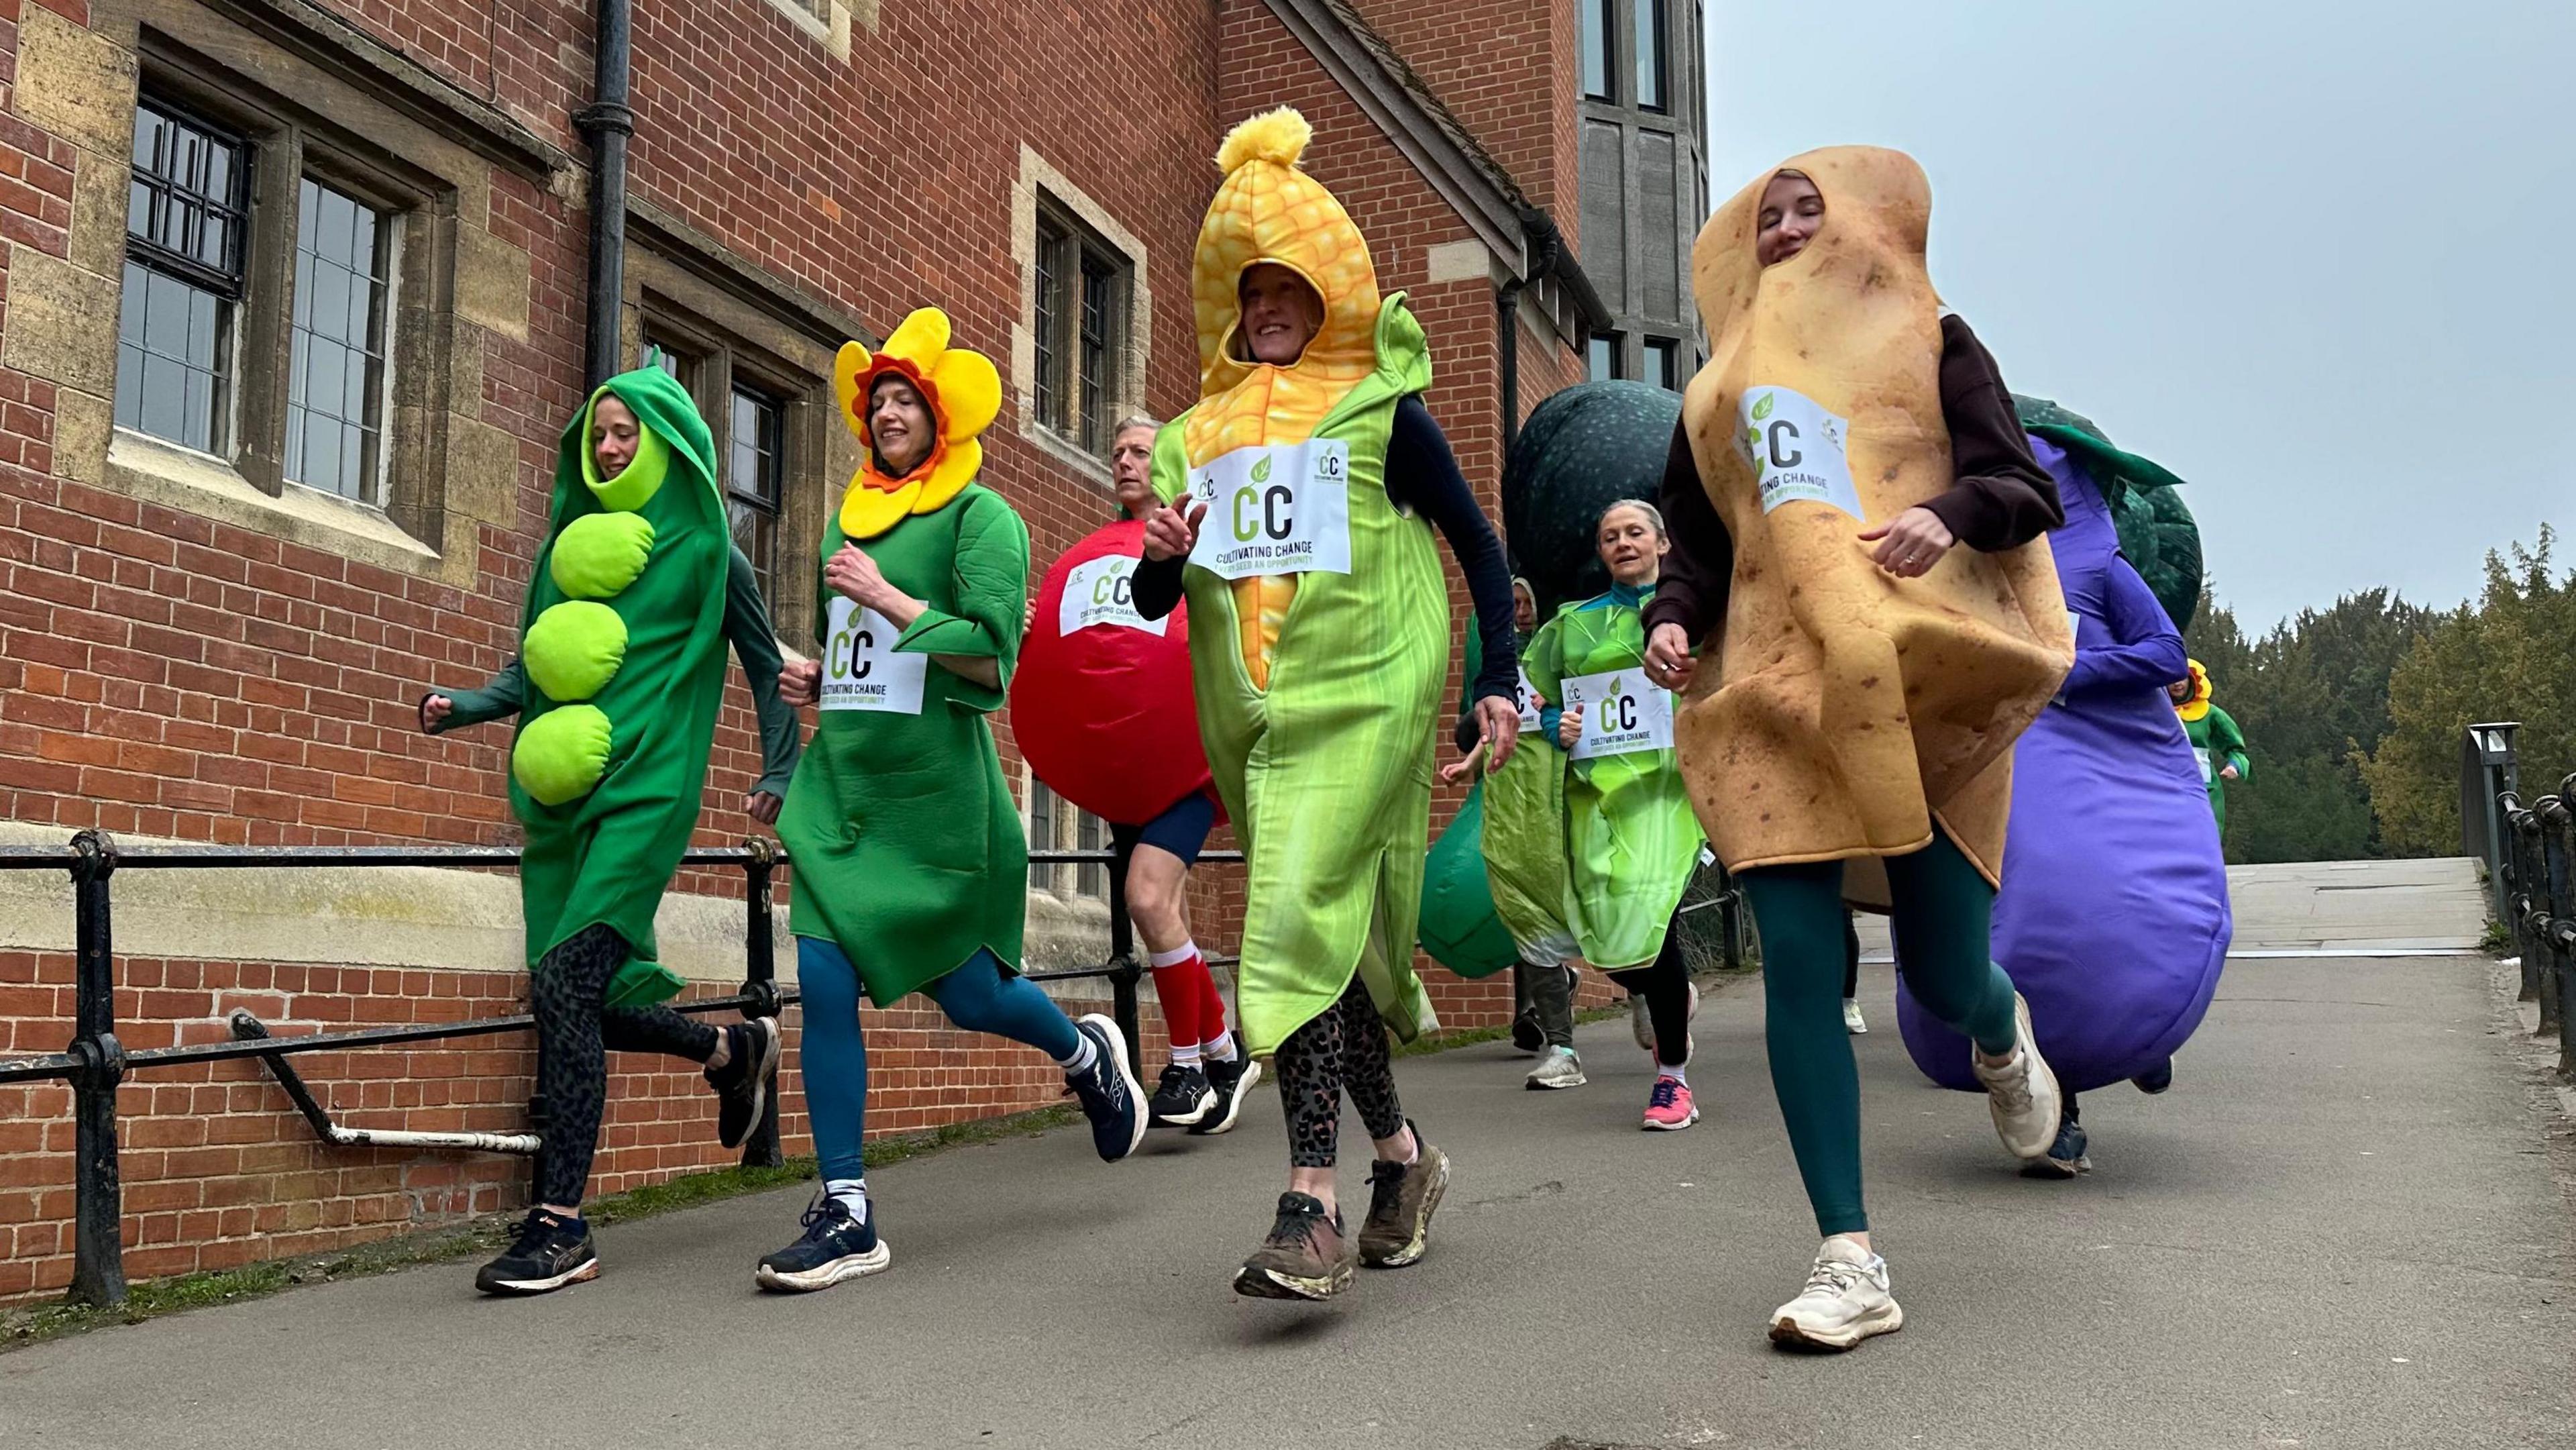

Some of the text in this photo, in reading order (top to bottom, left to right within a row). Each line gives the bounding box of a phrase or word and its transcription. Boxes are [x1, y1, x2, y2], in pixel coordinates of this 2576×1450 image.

[1320, 456, 1338, 475] CC
[1198, 478, 1214, 497] CC
[1783, 472, 1828, 488] CHANGE
[1233, 485, 1292, 542] CC
[1216, 541, 1313, 564] CULTIVATING CHANGE
[1093, 574, 1132, 605] CC
[831, 630, 873, 680] CC
[854, 684, 887, 695] CHANGE
[1516, 686, 1525, 714] C
[1568, 688, 1580, 700] CC
[1601, 695, 1636, 733] CC
